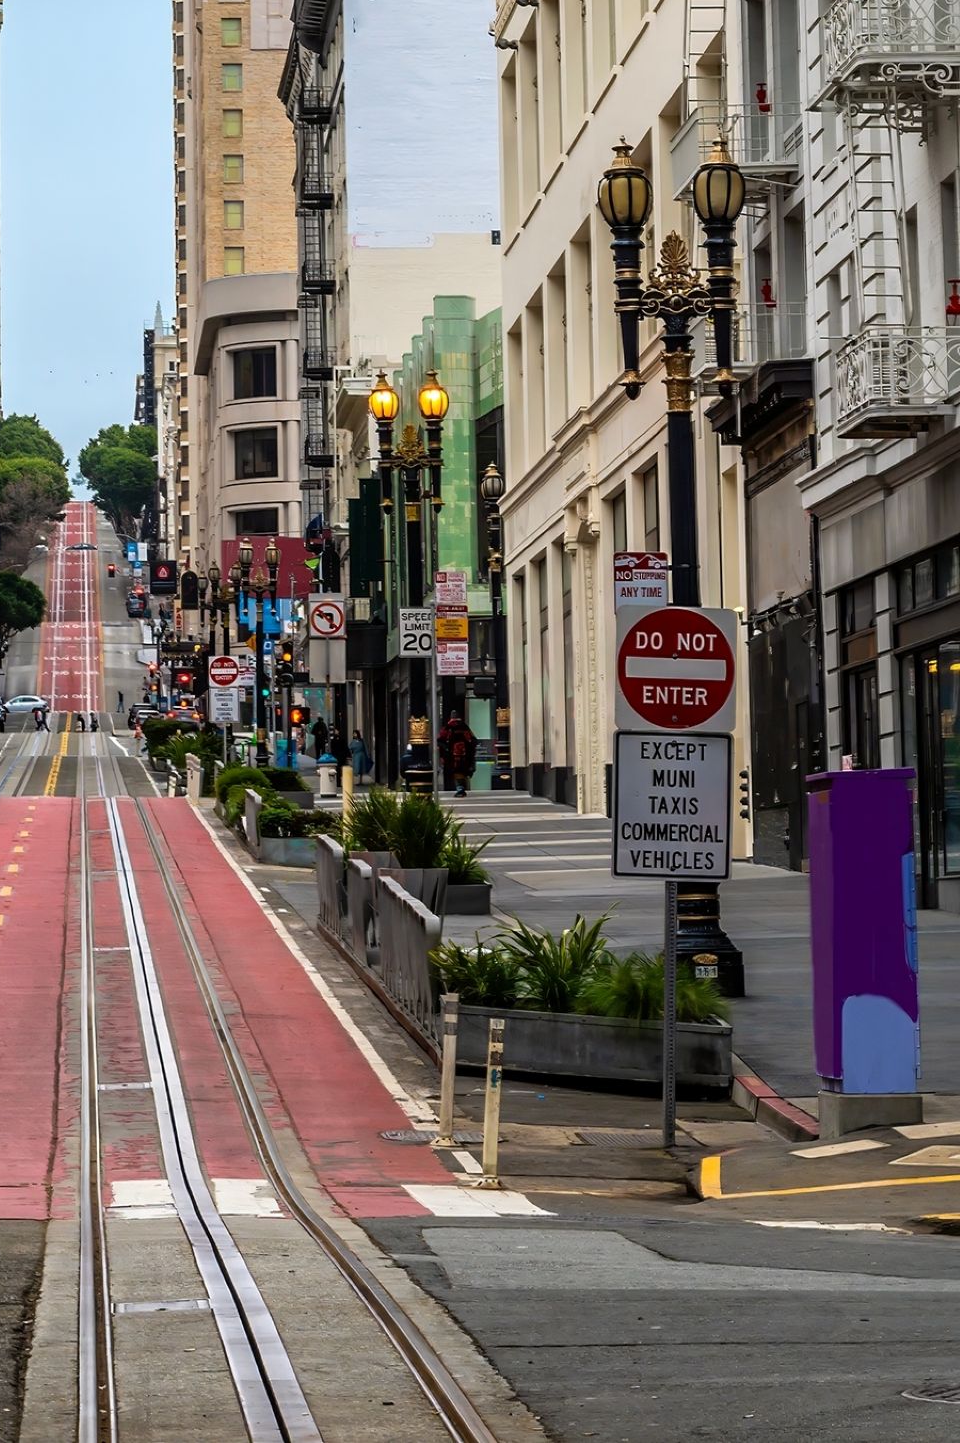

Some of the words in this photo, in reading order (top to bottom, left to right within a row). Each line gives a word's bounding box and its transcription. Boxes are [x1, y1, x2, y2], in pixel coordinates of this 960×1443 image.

[616, 570, 632, 580] NO
[634, 571, 666, 580] STOPPING
[620, 587, 639, 597] ANY
[641, 587, 662, 598] TIME
[404, 623, 431, 631] LIMIT
[403, 632, 432, 651] 20
[635, 631, 663, 650] DO
[677, 632, 718, 652] NOT
[642, 685, 708, 706] ENTER
[640, 741, 708, 761] EXCEPT
[652, 769, 695, 788] MUNI
[648, 796, 699, 816] TAXIS
[621, 822, 724, 843] COMMERCIAL
[629, 849, 715, 870] VEHICLES
